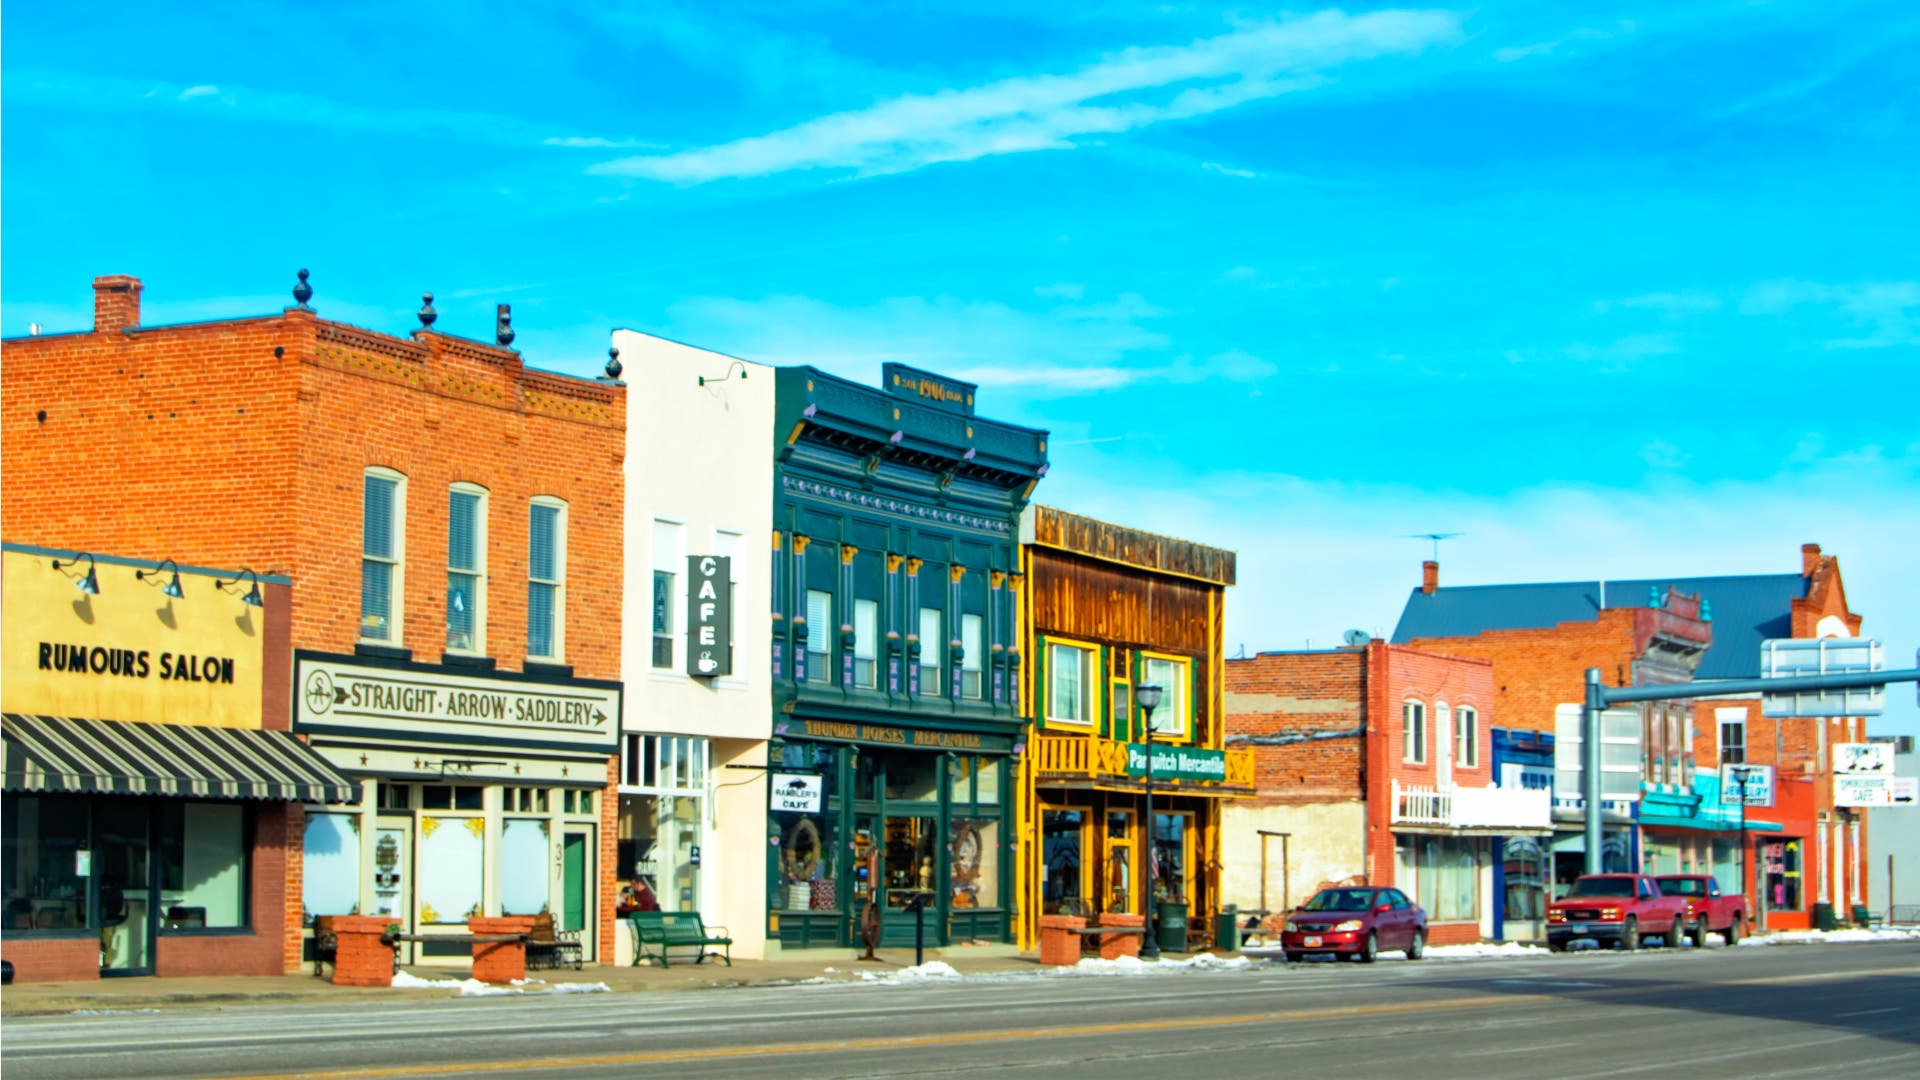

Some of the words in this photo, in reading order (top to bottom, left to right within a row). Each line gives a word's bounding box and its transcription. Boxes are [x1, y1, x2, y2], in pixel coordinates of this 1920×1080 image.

[698, 557, 717, 645] CAFE
[39, 642, 149, 678] RUMOURS
[160, 652, 234, 684] SALON
[351, 682, 437, 714] STRAIGHT
[447, 692, 507, 720] ARROW
[515, 697, 593, 726] SADDLERY
[806, 721, 857, 739] THUNDER
[914, 731, 979, 747] MERCANTILE
[1178, 753, 1224, 774] Mercantile
[775, 789, 817, 798] RAMBLER'S
